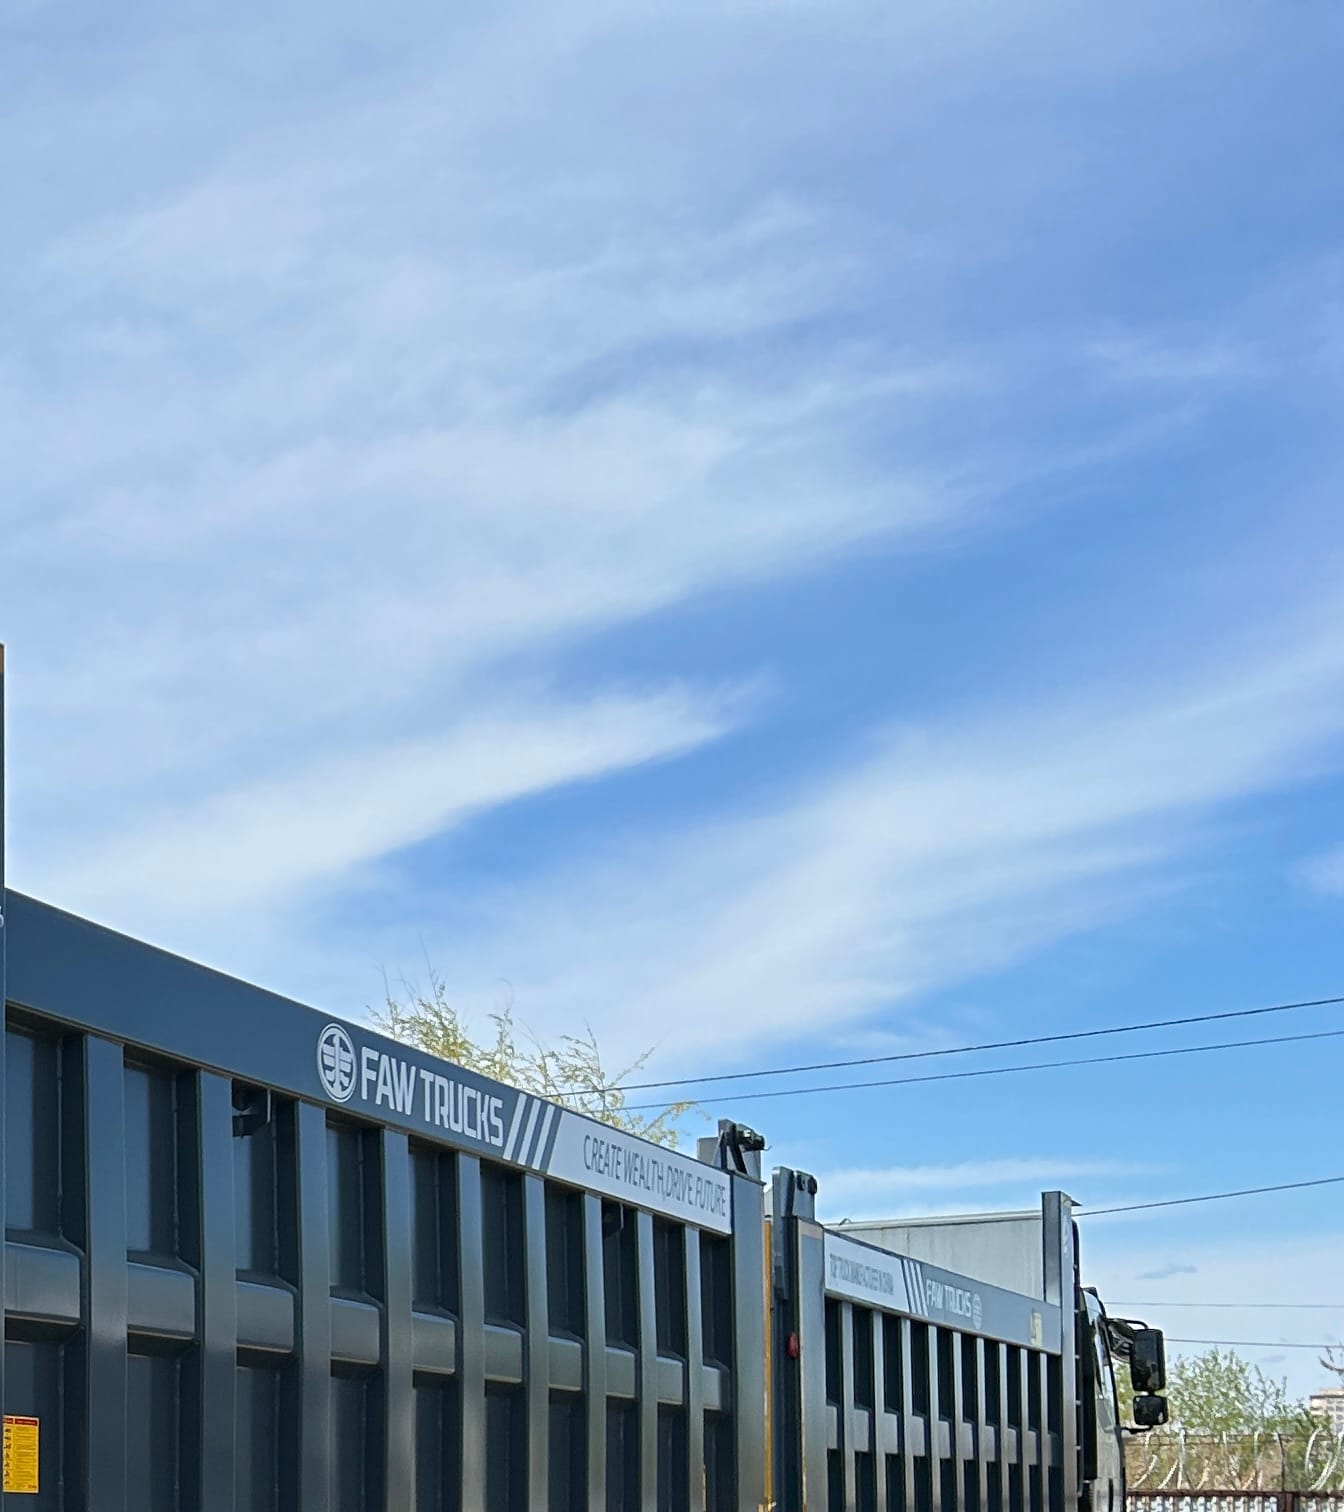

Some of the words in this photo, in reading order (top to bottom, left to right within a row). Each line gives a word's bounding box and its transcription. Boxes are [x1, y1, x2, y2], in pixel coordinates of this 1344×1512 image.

[362, 1046, 417, 1116] FAW
[419, 1068, 504, 1148] TRUCKS
[583, 1134, 622, 1180] CREATE
